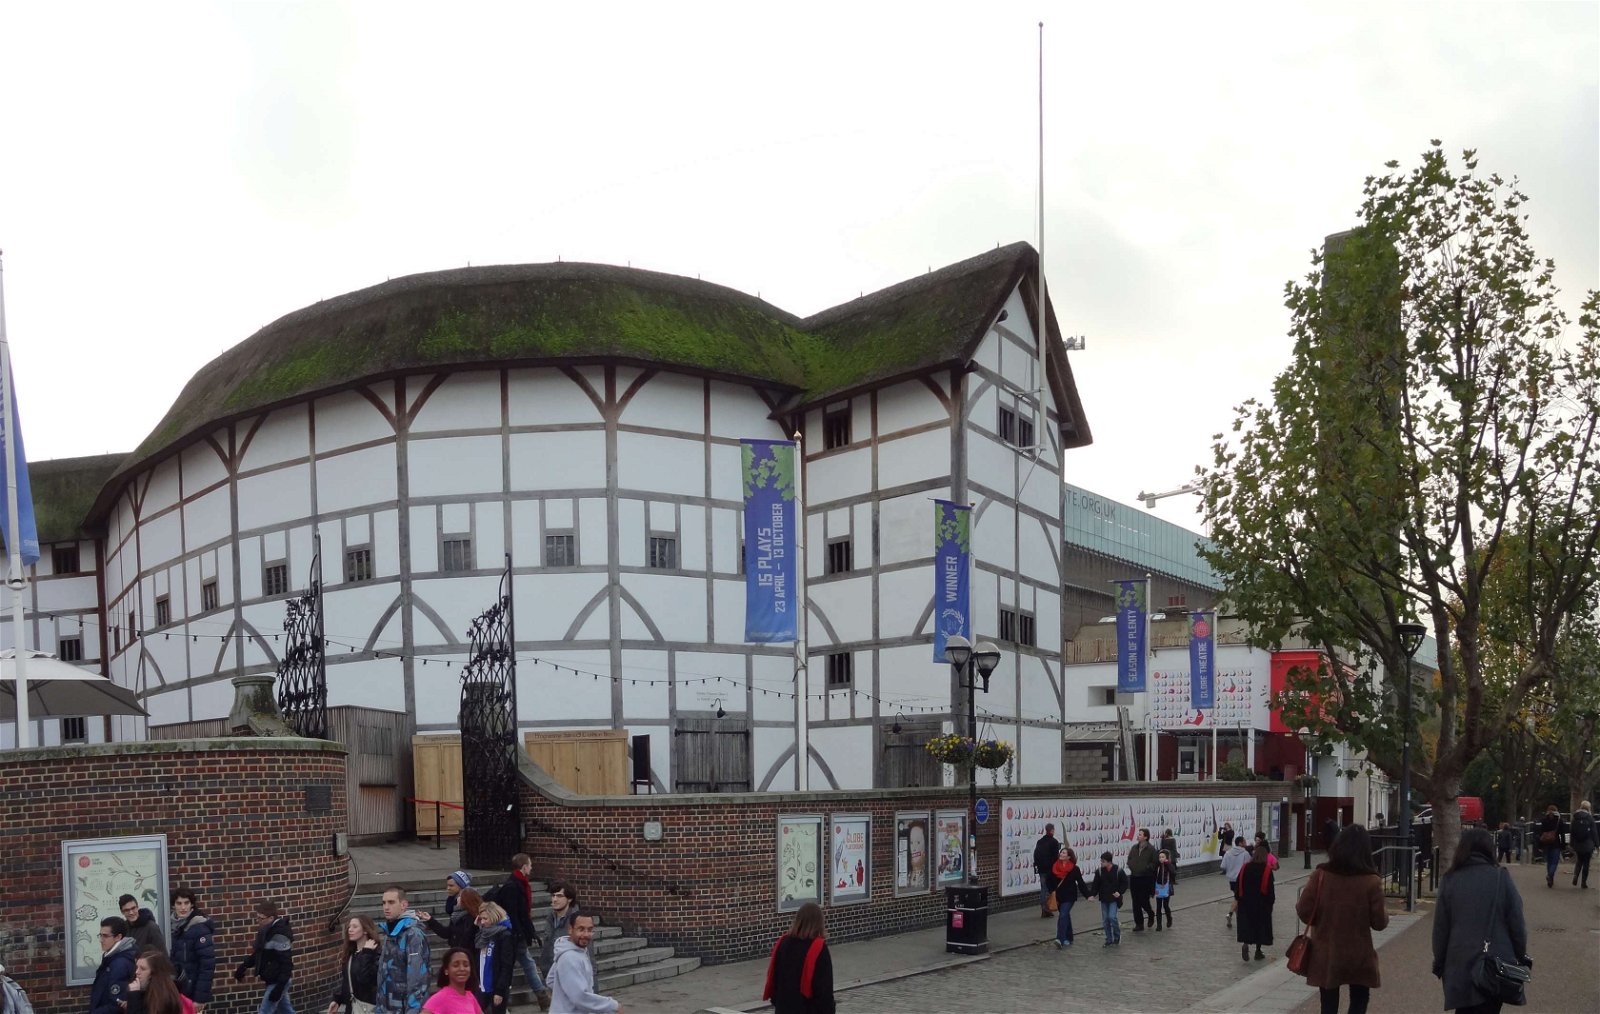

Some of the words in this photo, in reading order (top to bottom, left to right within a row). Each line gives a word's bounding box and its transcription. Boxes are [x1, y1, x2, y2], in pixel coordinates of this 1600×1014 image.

[772, 503, 784, 546] OCTOBER
[757, 527, 772, 569] PLAYS
[773, 548, 784, 558] 13
[758, 573, 773, 586] 15
[774, 572, 785, 598] APRIL
[946, 556, 958, 602] WINNER
[774, 600, 786, 613] 23
[1127, 609, 1137, 639] PLENTY
[1128, 641, 1137, 651] OF
[1198, 641, 1208, 674] THEATRE
[1128, 652, 1137, 682] SEASON
[1200, 675, 1208, 699] GLOBE
